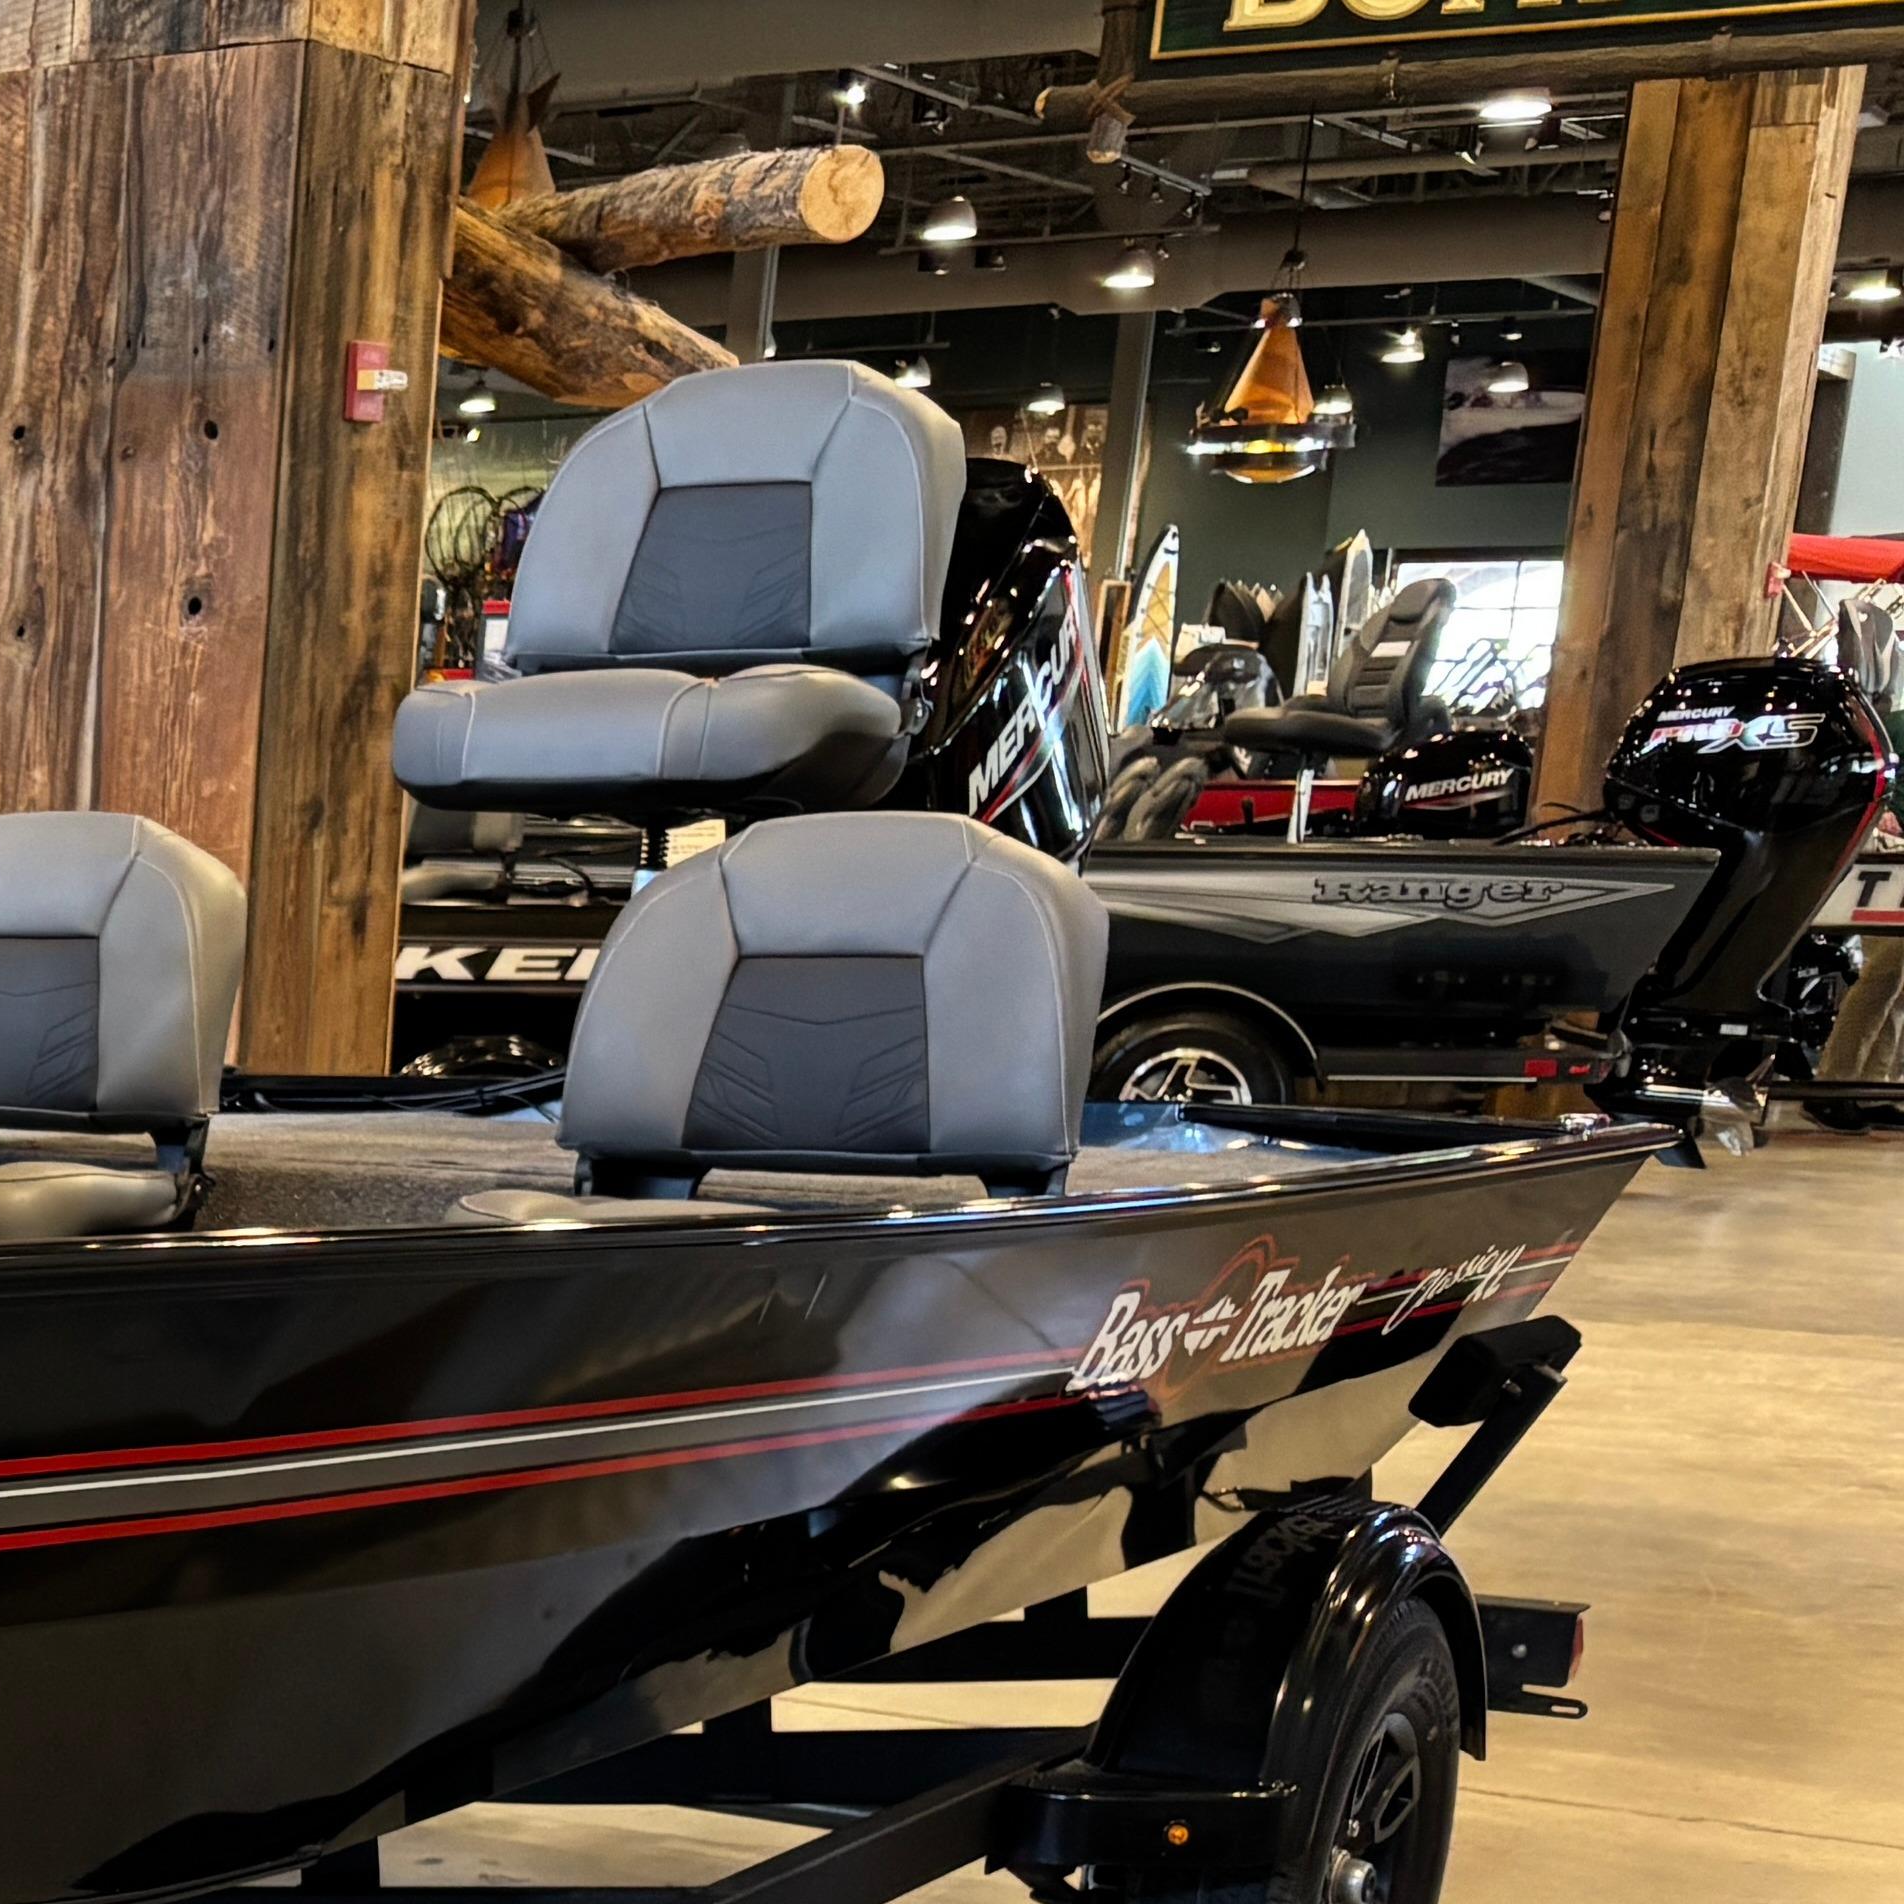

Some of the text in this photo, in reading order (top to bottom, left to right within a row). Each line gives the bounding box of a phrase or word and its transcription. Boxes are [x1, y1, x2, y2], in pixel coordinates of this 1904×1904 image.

[968, 604, 1078, 818] MERCUR
[1656, 705, 1737, 722] MERCURY
[1404, 766, 1516, 802] MERCURY
[1311, 876, 1565, 911] Ranger
[1065, 1290, 1186, 1393] Bass
[1220, 1266, 1369, 1363] Tracker
